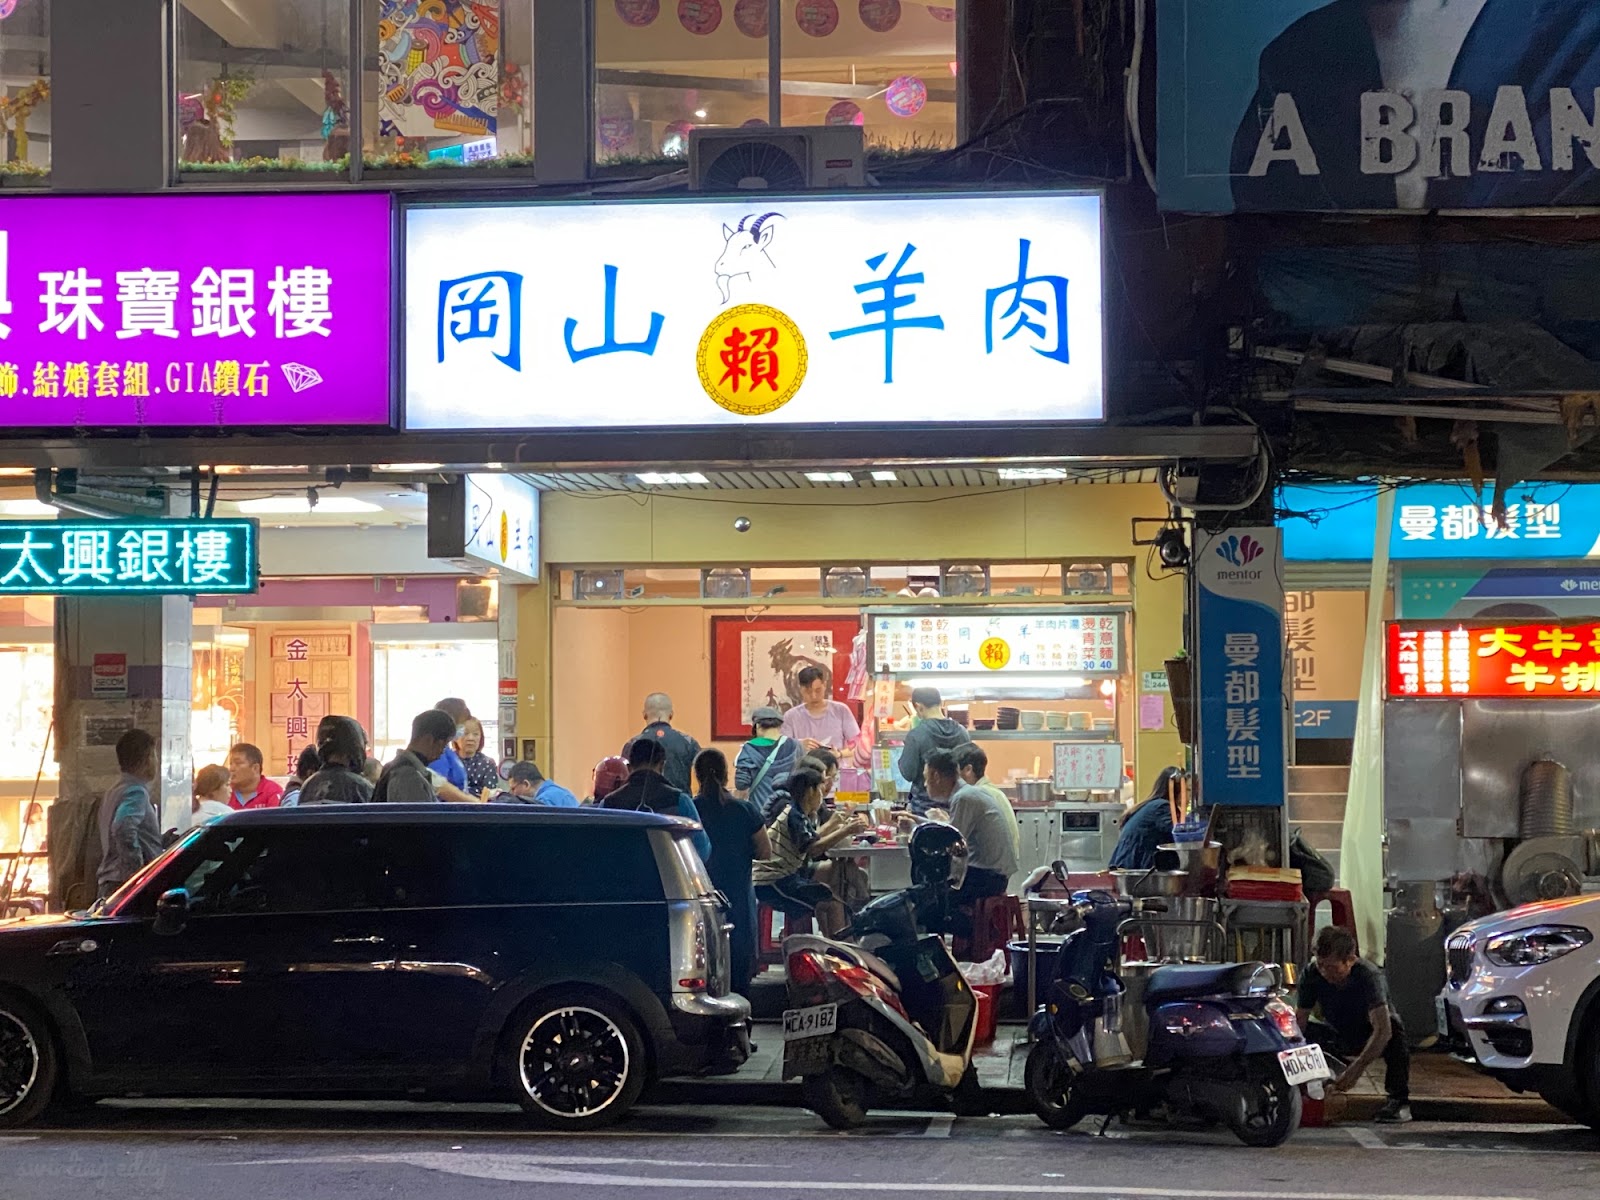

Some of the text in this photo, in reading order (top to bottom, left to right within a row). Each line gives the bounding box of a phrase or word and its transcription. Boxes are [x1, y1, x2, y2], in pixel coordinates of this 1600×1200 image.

[1248, 92, 1320, 177] A
[38, 265, 333, 341] 珠寶銀樓
[437, 237, 1071, 394] 岡山 賴 羊肉
[0, 529, 231, 584] 太興銀樓
[1217, 570, 1263, 580] mentor
[1579, 580, 1600, 591] me
[985, 643, 1004, 664] 賴
[1082, 617, 1096, 660] 燙青菜
[1099, 617, 1114, 660] 乾意麵
[1477, 628, 1600, 658] 大牛
[921, 660, 934, 670] 30
[936, 660, 949, 670] 40
[1083, 660, 1095, 670] 30
[1100, 660, 1112, 669] 40
[1224, 633, 1262, 778] 曼都髮型
